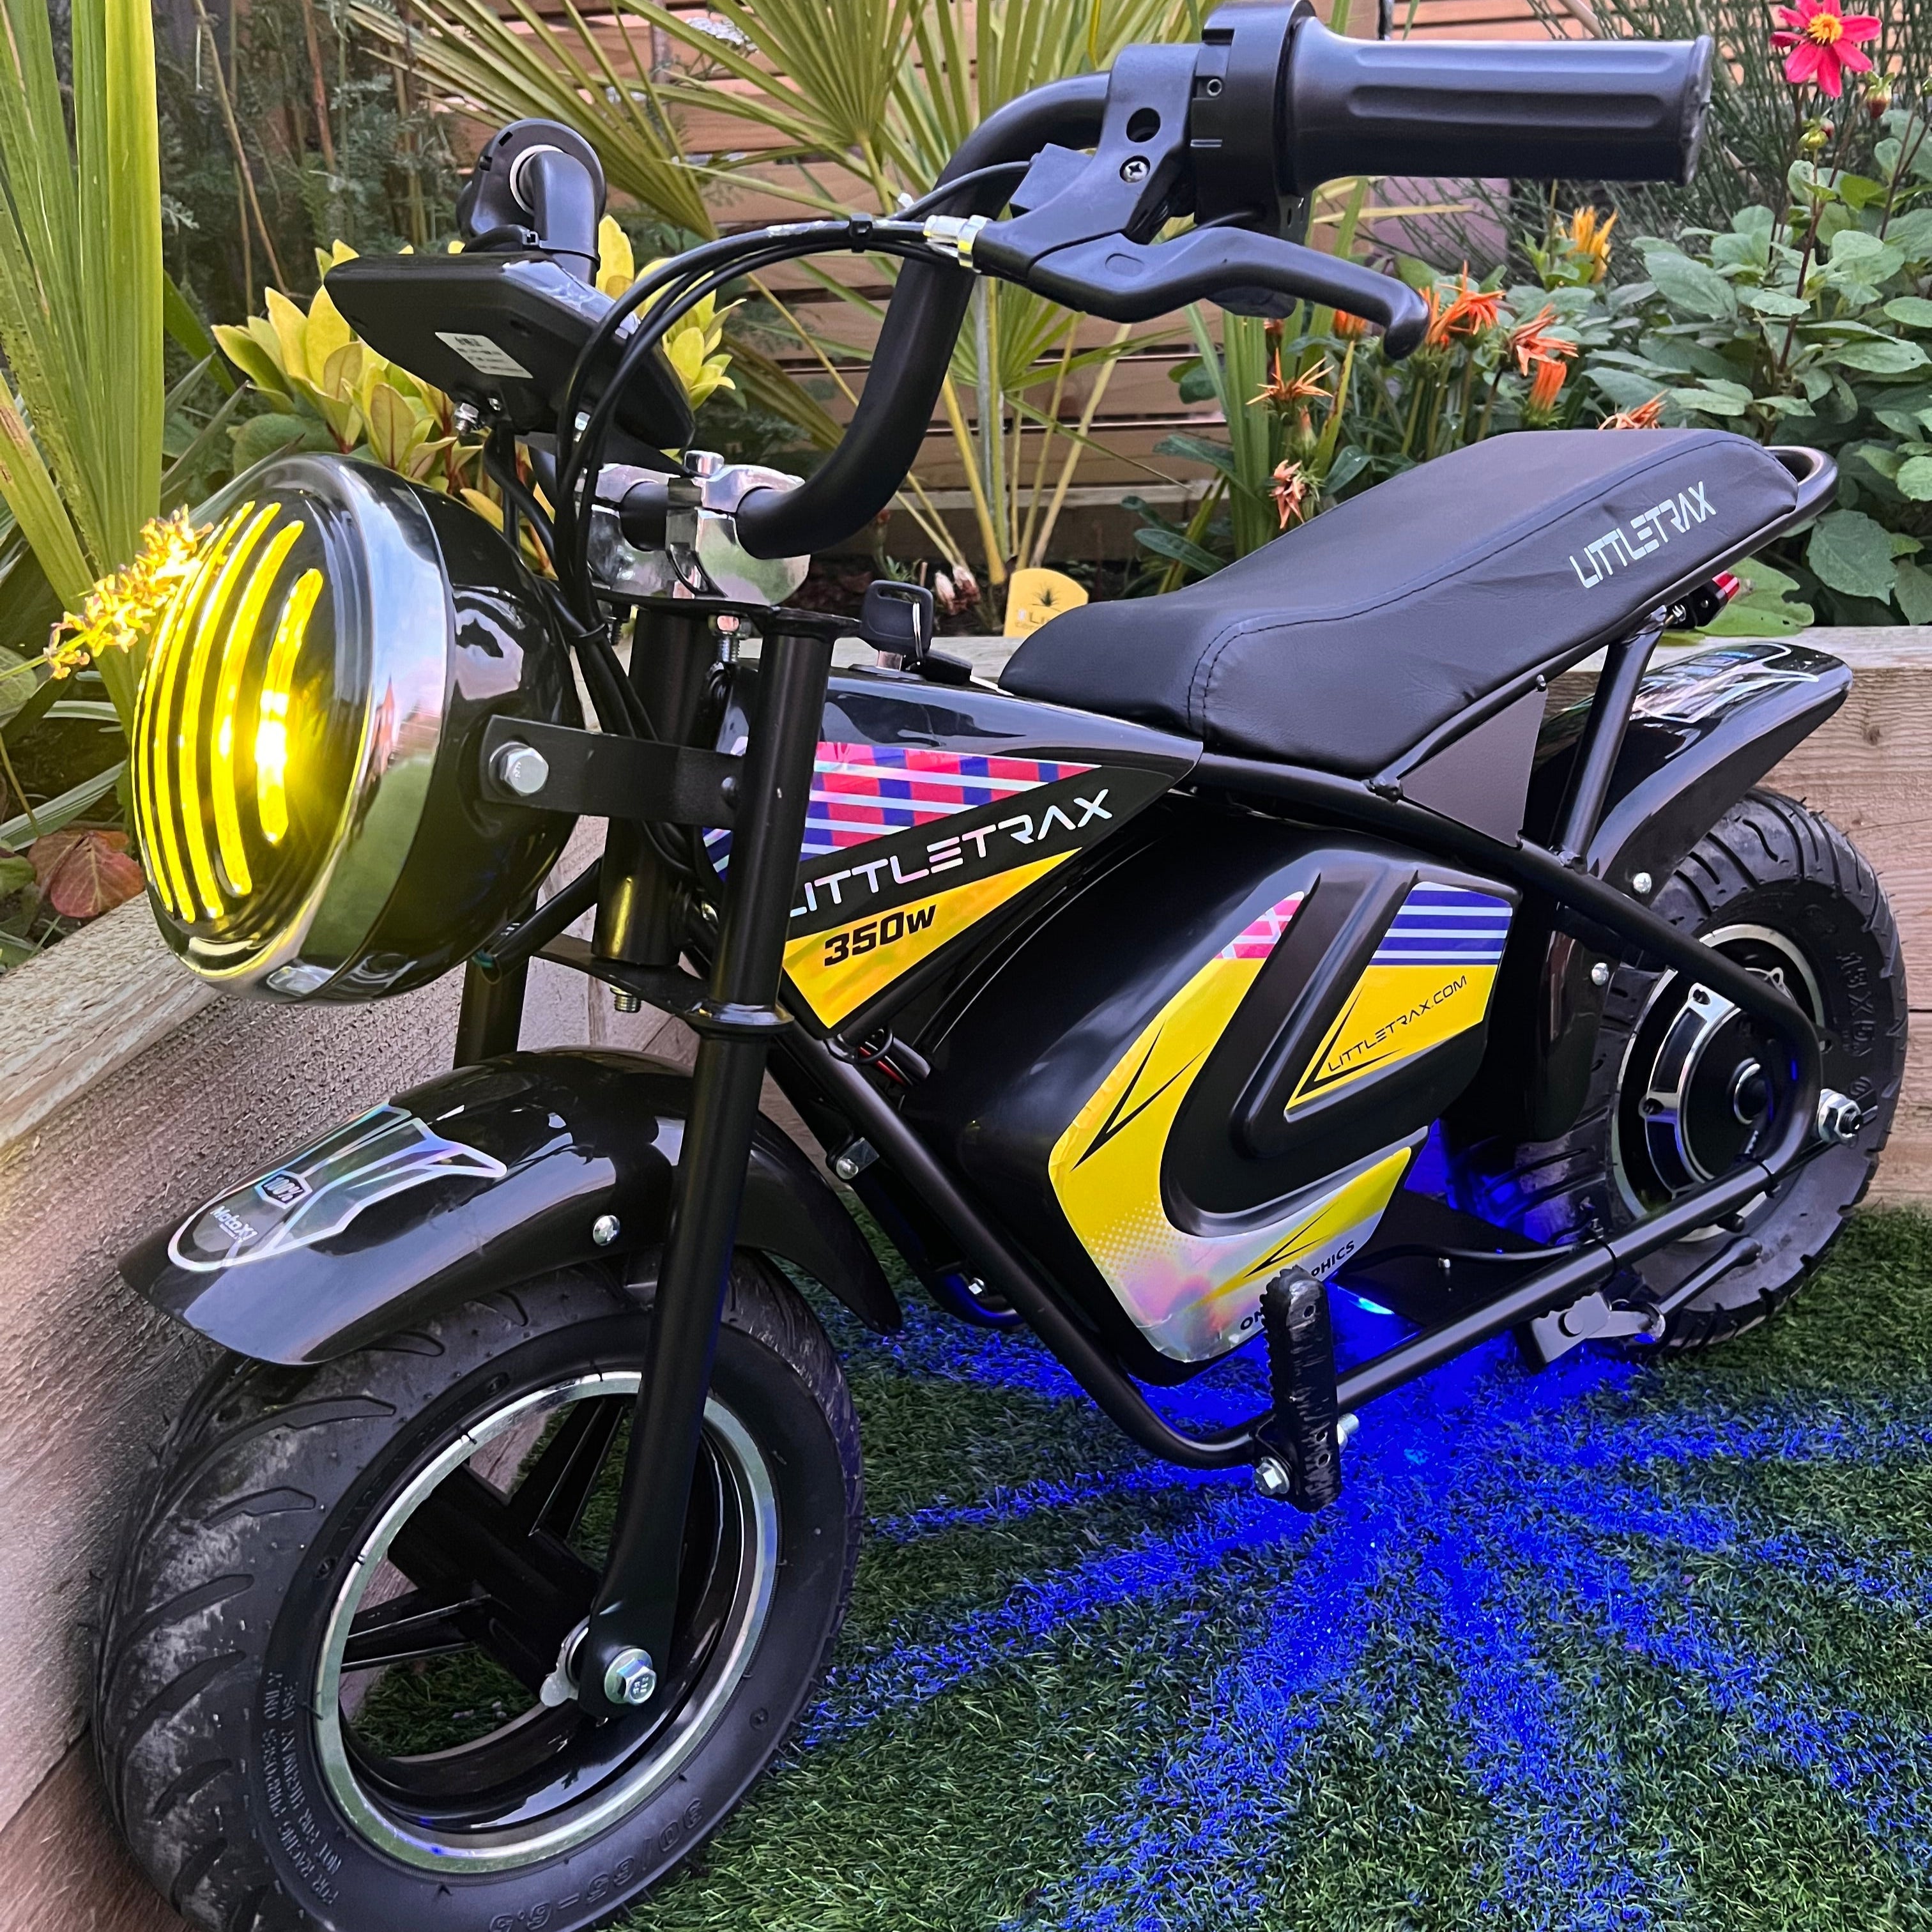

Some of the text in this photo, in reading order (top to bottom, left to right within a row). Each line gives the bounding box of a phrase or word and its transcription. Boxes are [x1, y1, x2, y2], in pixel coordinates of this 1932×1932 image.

[1569, 480, 1717, 588] LITTLETRAX
[1328, 975, 1468, 1072] LITTLETRAX.COM
[262, 1728, 288, 1819] PURPOSES
[277, 1820, 316, 1879] RACING
[315, 1841, 342, 1875] NOT
[312, 1873, 340, 1906] FOR
